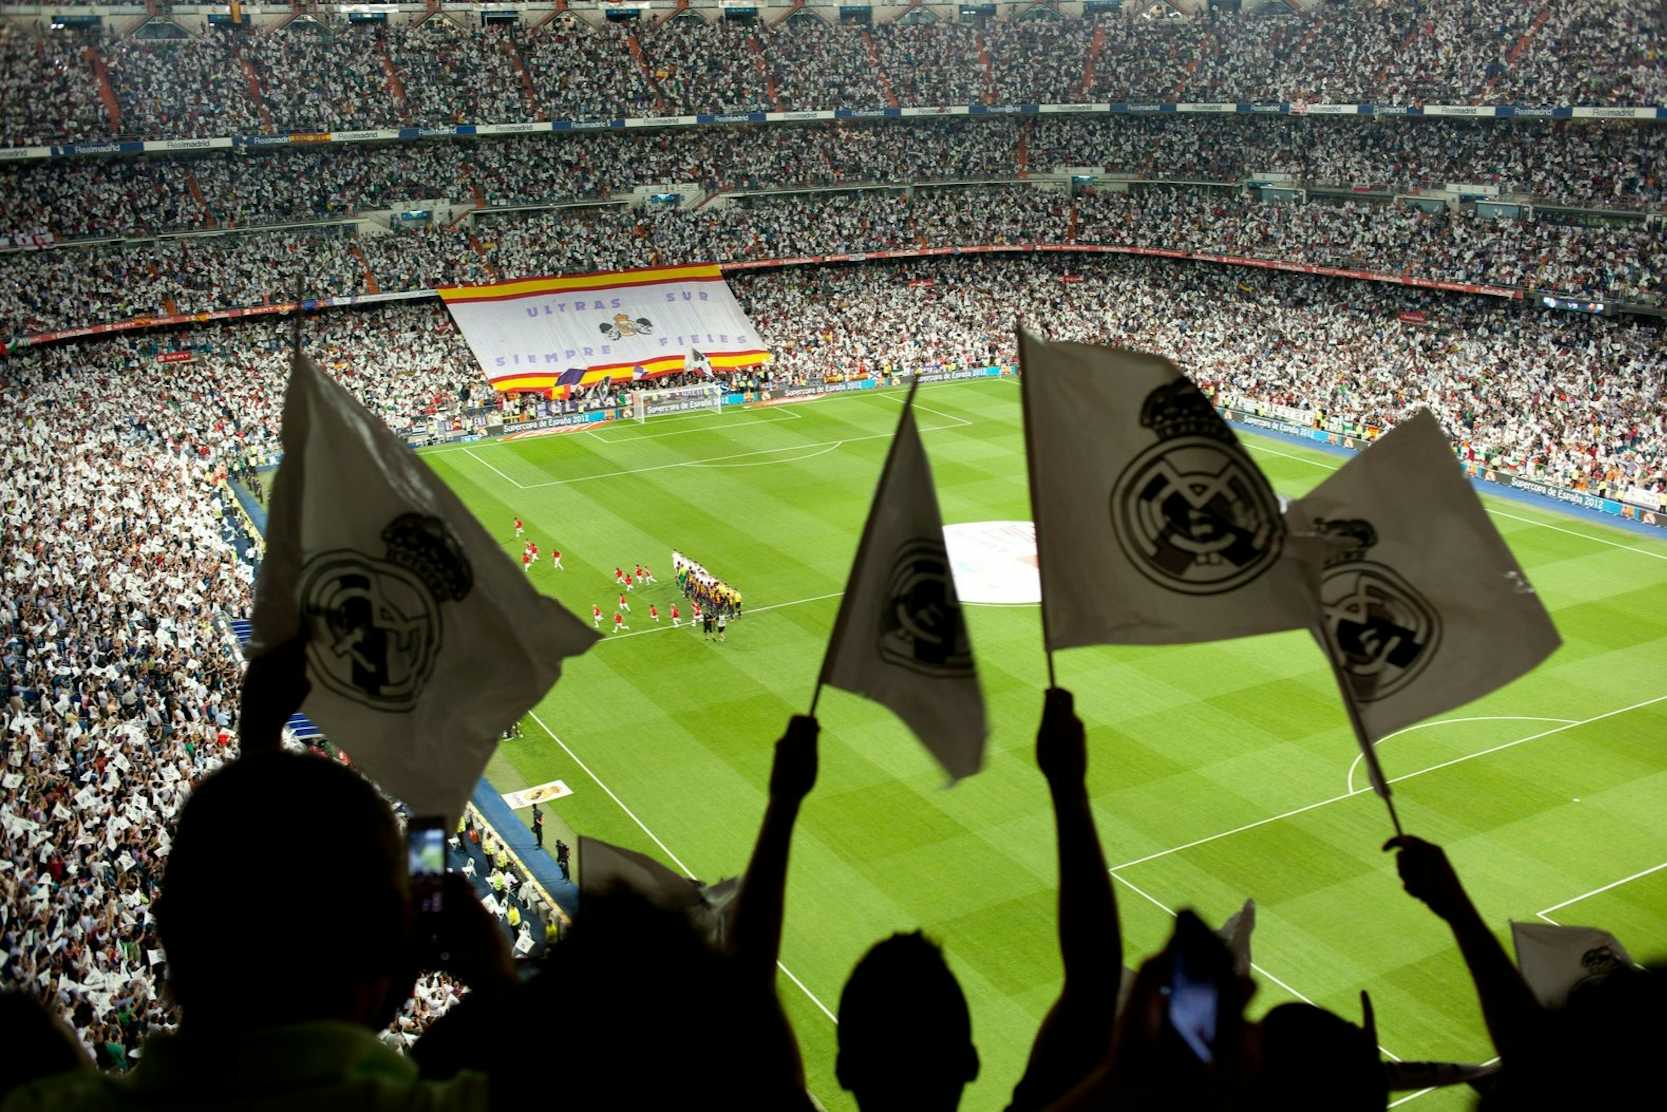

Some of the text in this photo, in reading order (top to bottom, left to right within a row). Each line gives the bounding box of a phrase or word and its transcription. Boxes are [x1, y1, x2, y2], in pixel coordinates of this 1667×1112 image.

[527, 291, 708, 318] ULTRAS SUR
[495, 334, 747, 367] SIEMPRE FIELES
[503, 414, 590, 433] Supercopa de España 2012
[1511, 477, 1604, 509] Supercopa de España 2012
